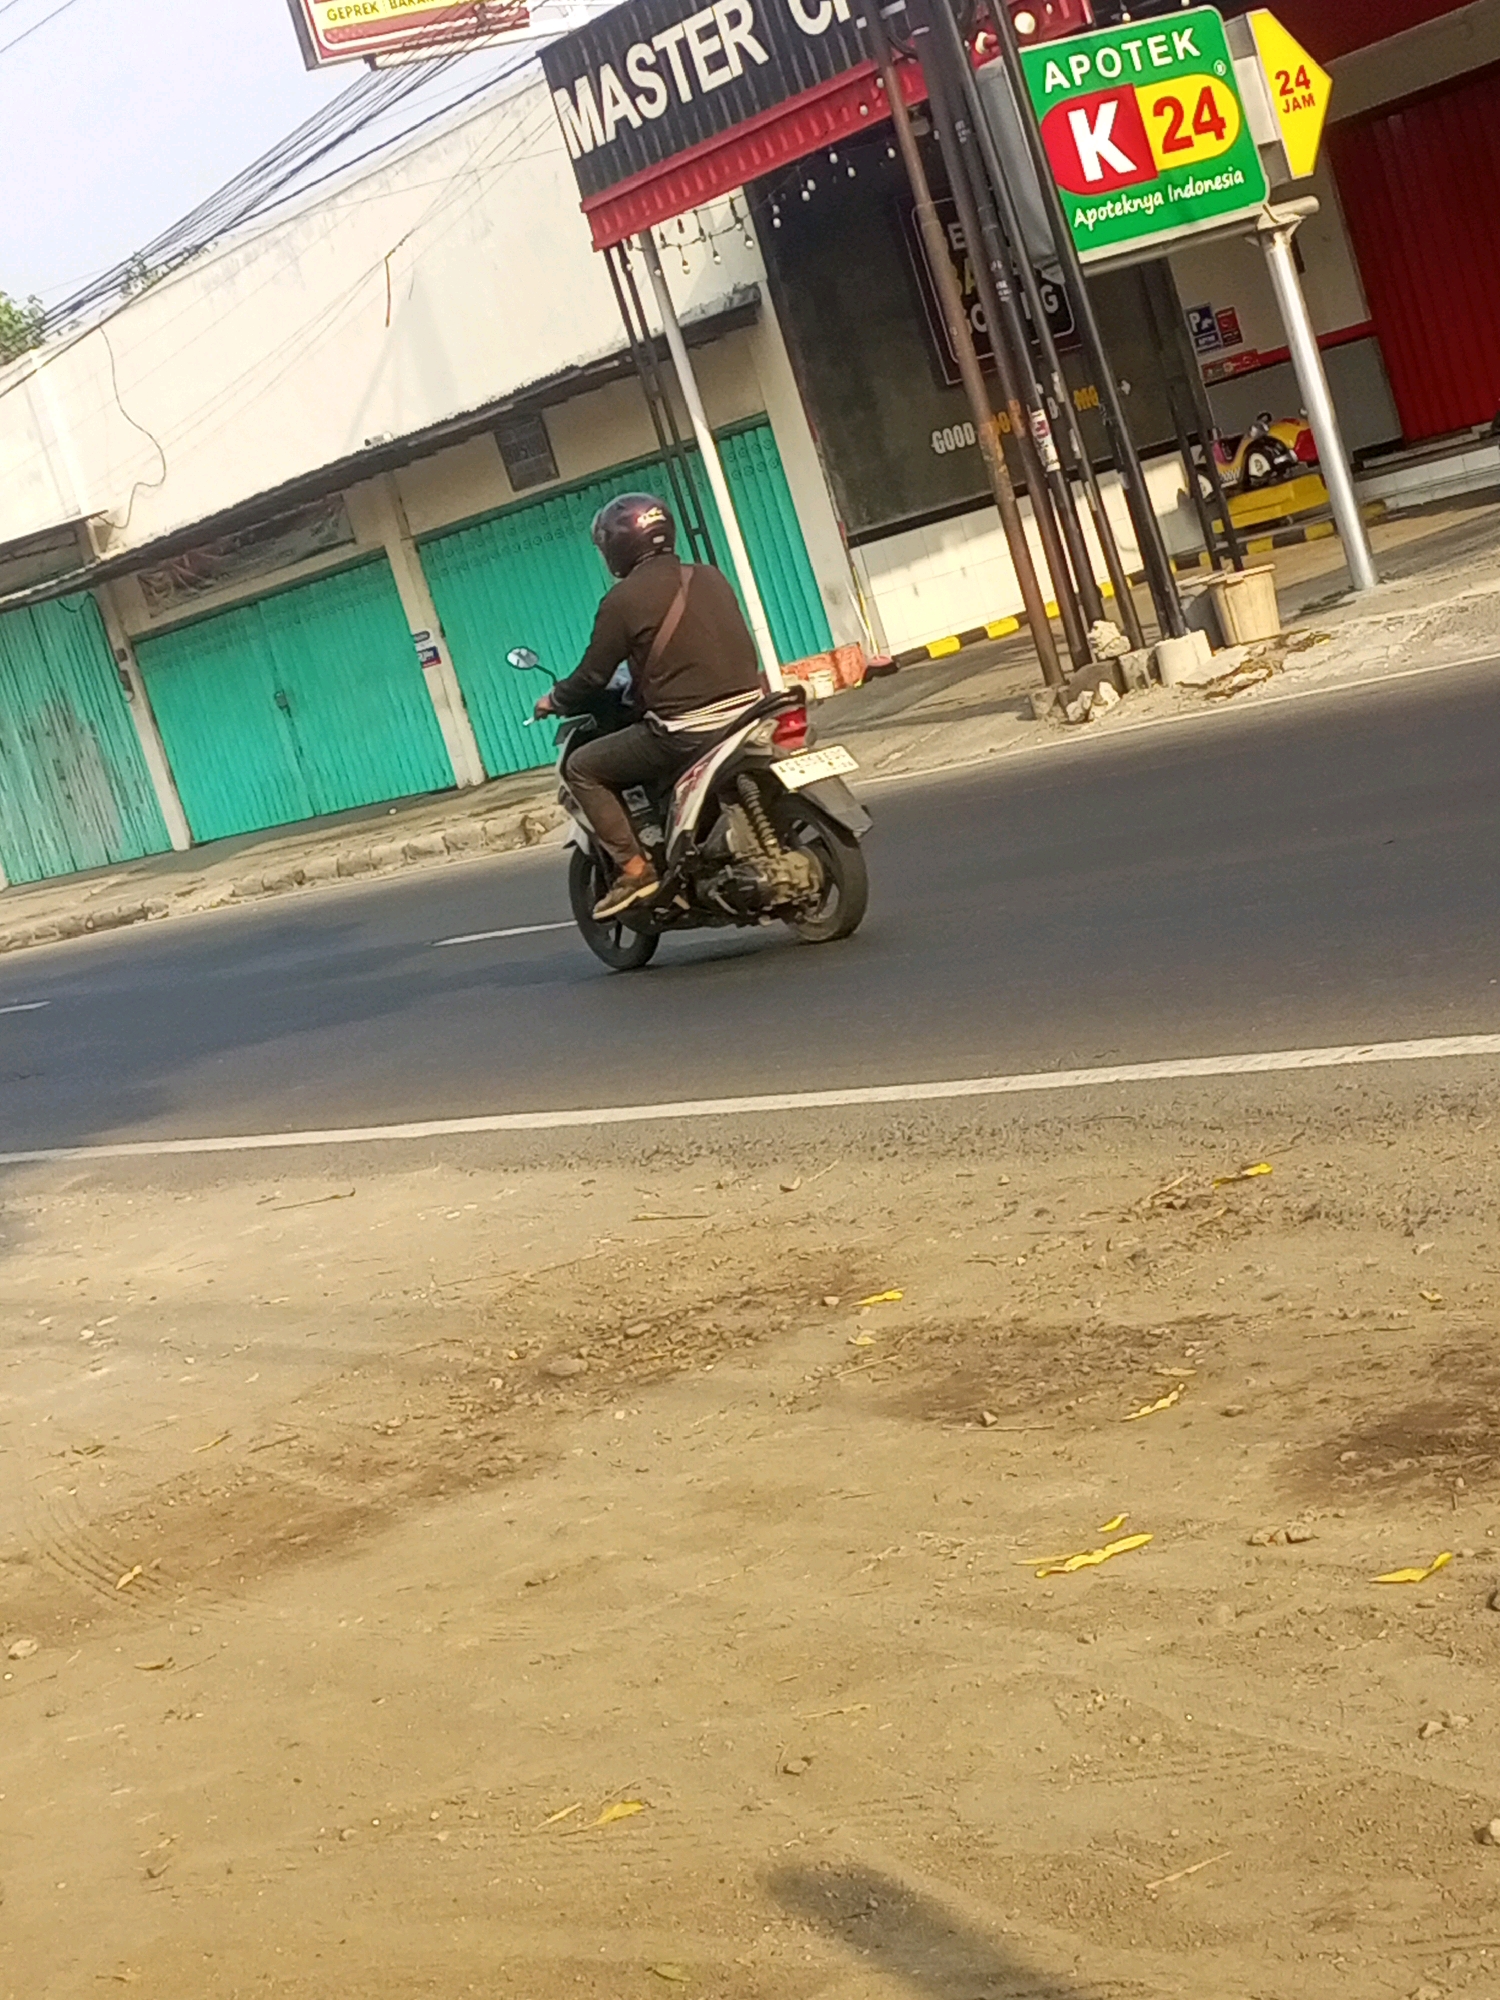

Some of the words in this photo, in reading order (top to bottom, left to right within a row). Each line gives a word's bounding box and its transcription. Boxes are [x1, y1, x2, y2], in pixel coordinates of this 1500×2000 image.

[327, 1, 379, 21] GEPREK
[553, 0, 769, 159] MASTER
[1043, 27, 1200, 94] APOTEK
[1275, 64, 1312, 97] 24
[1282, 92, 1316, 114] JAM
[1067, 99, 1137, 182] K
[1152, 85, 1227, 154] 24
[1073, 191, 1165, 231] Apoteknya
[1168, 166, 1244, 203] Indonesia
[931, 422, 977, 454] GOOD
